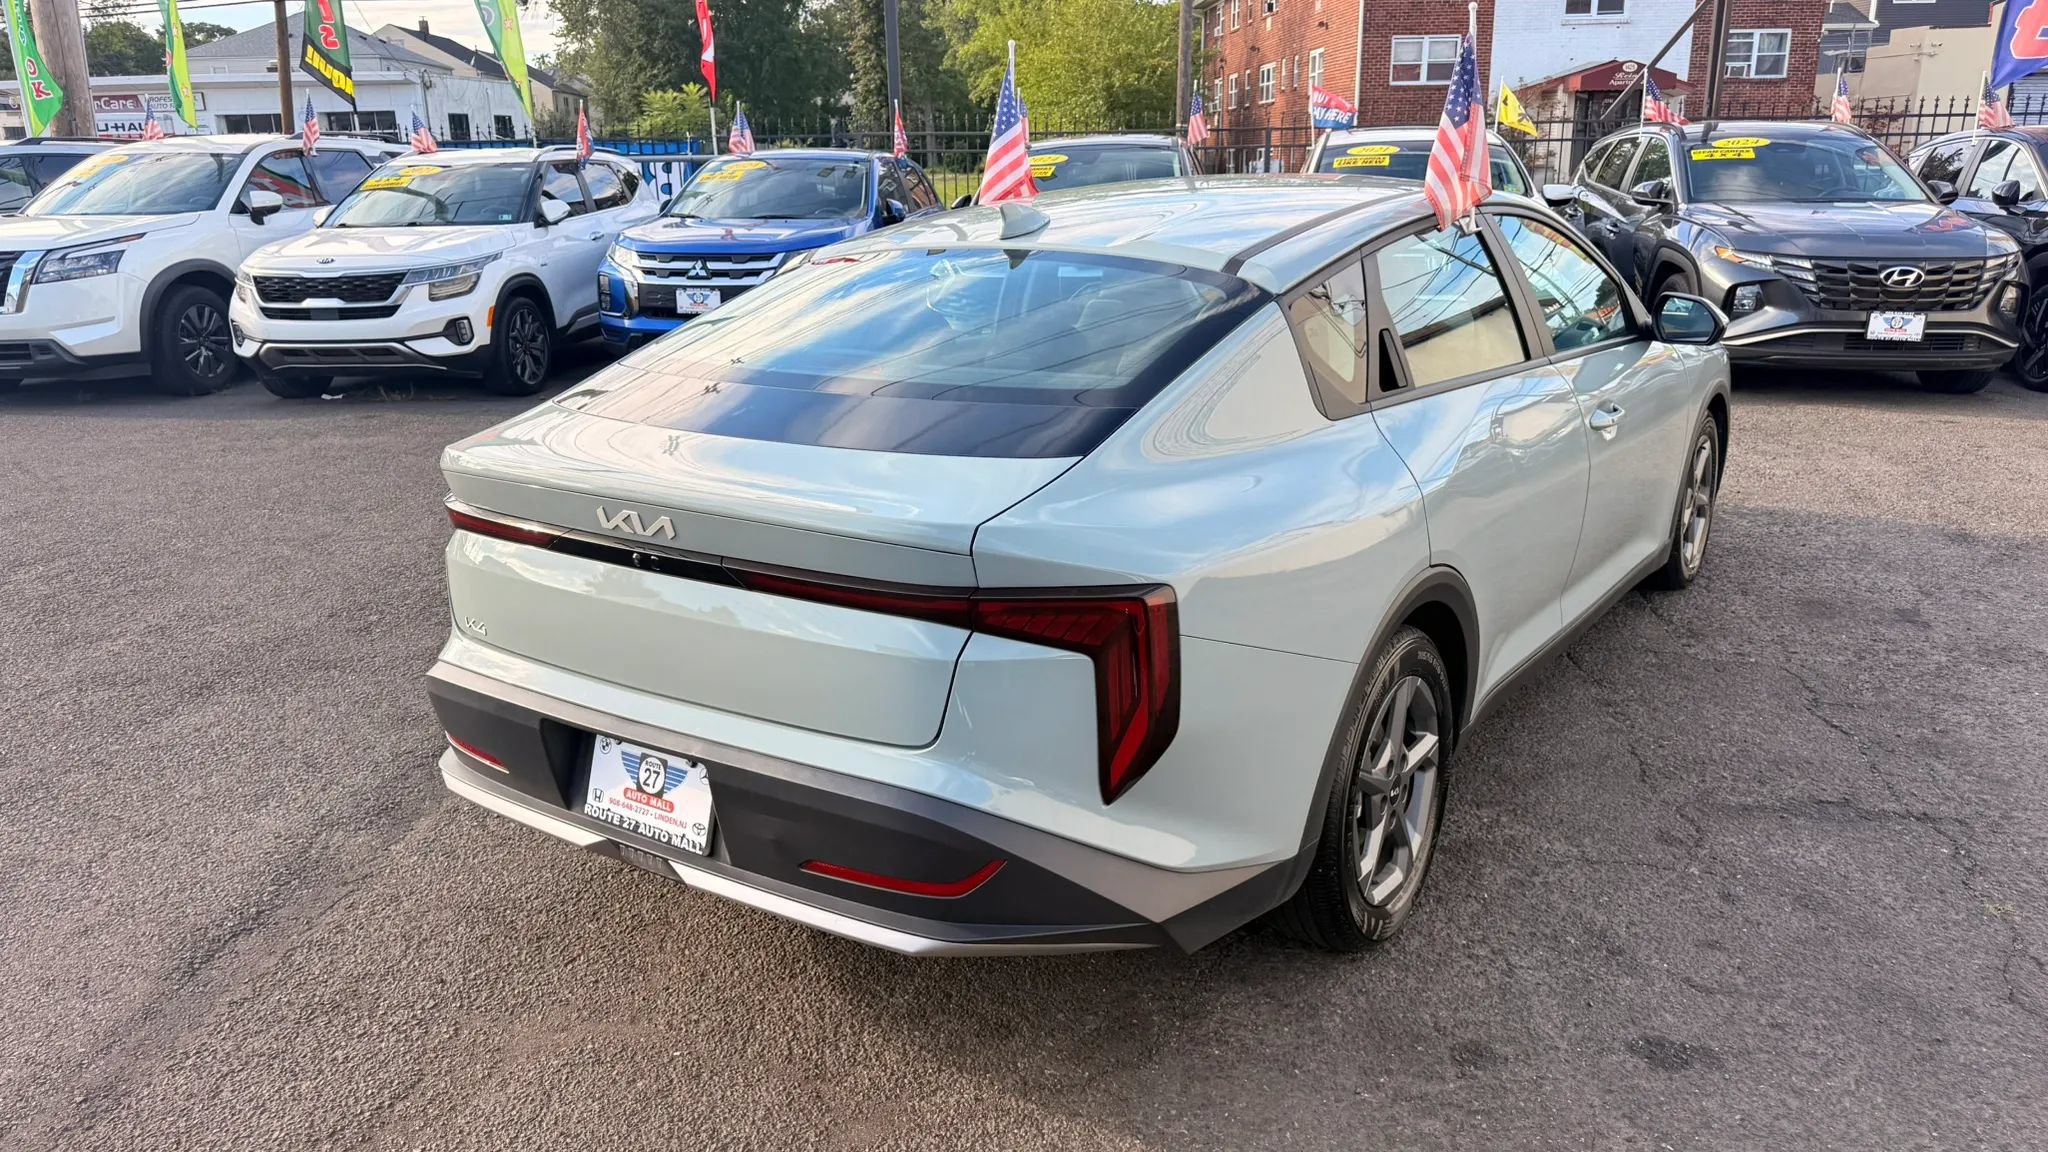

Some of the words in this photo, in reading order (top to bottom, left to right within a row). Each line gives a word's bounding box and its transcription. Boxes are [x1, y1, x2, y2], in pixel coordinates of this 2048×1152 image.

[1325, 108, 1352, 124] HERE
[596, 505, 677, 541] KIA
[645, 759, 661, 771] ROUTE
[642, 768, 660, 789] 27
[626, 790, 647, 803] AUTO
[649, 797, 671, 810] MALL
[584, 804, 624, 824] ROUTE
[622, 816, 635, 831] 27
[637, 822, 669, 843] AUTO
[671, 832, 703, 855] MALL
